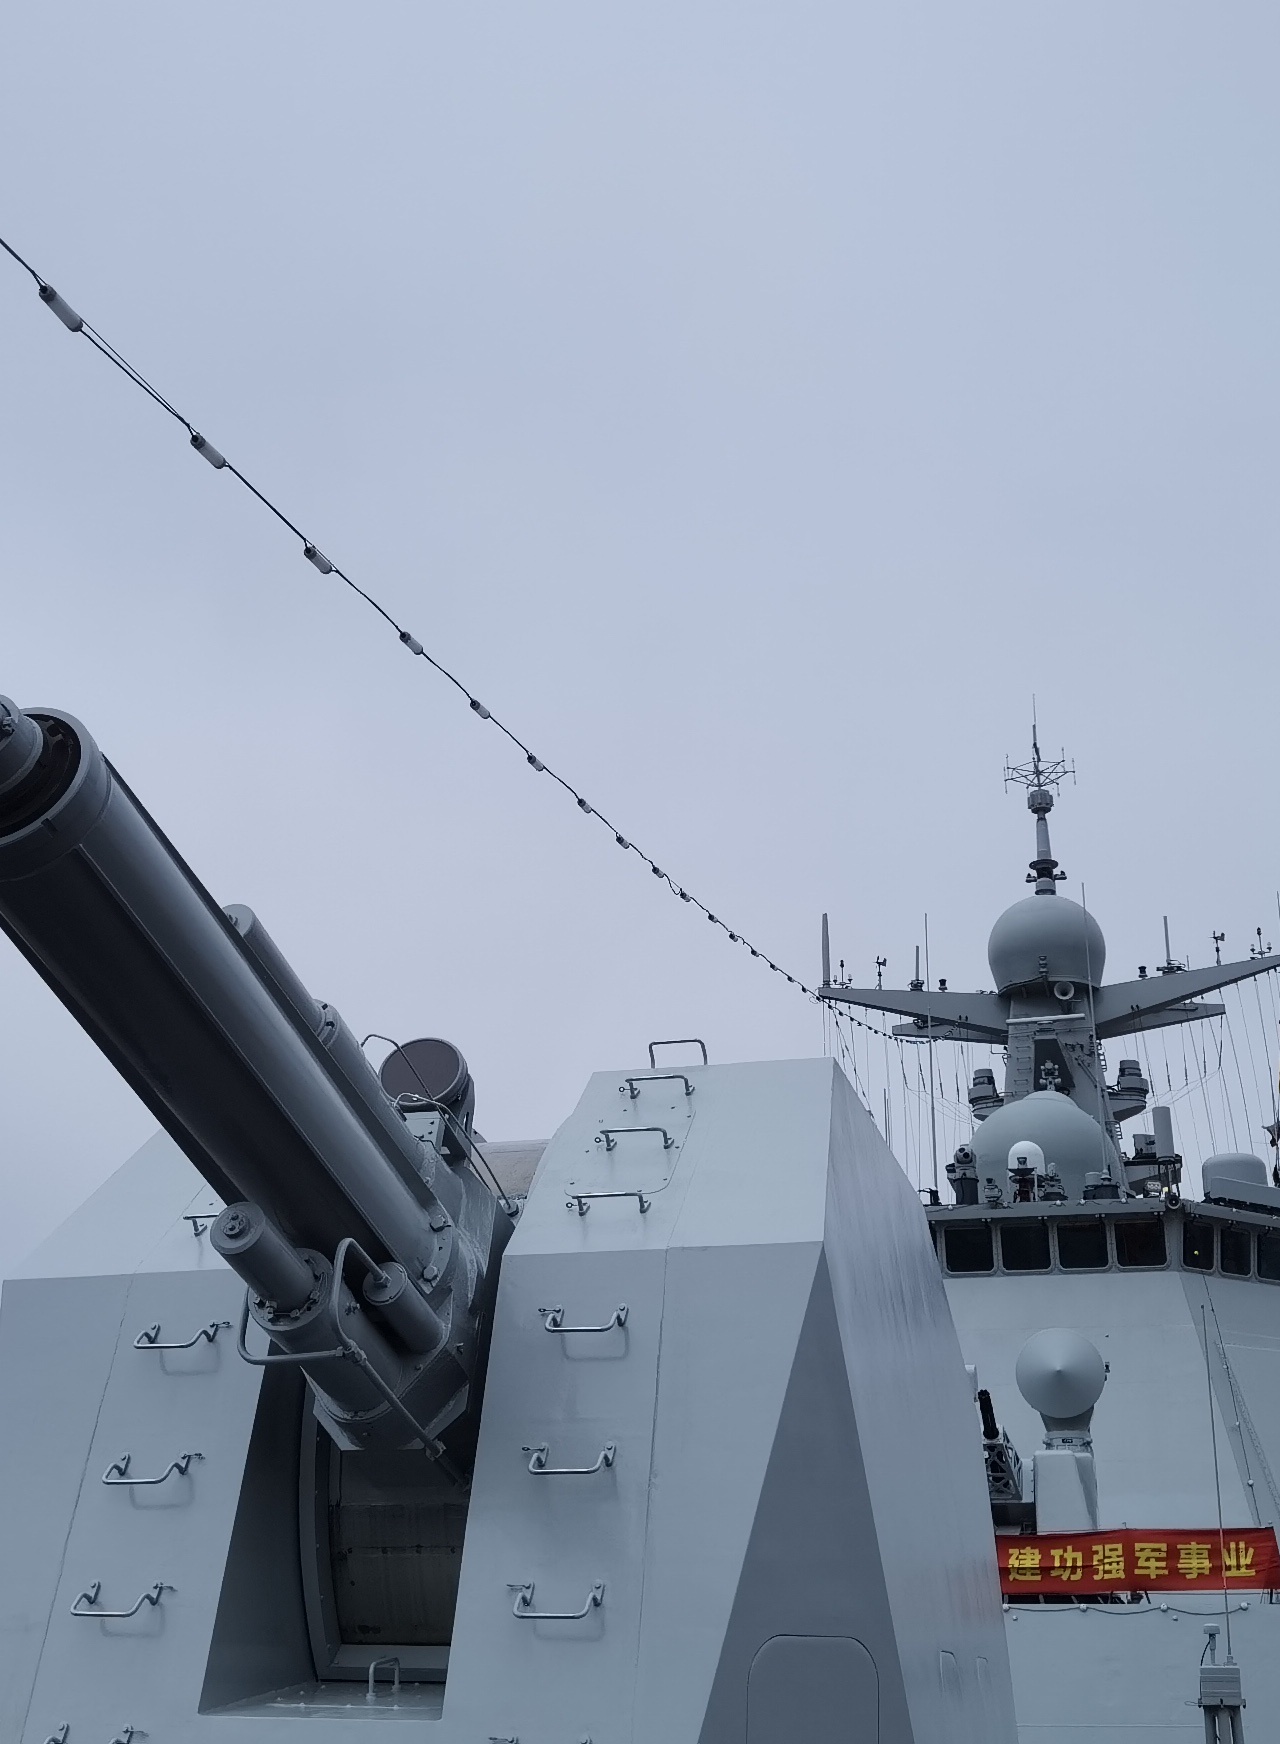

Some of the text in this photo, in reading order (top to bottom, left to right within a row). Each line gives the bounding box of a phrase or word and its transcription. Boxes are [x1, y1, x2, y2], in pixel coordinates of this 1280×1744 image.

[1008, 1541, 1256, 1581] 建功强军事业
